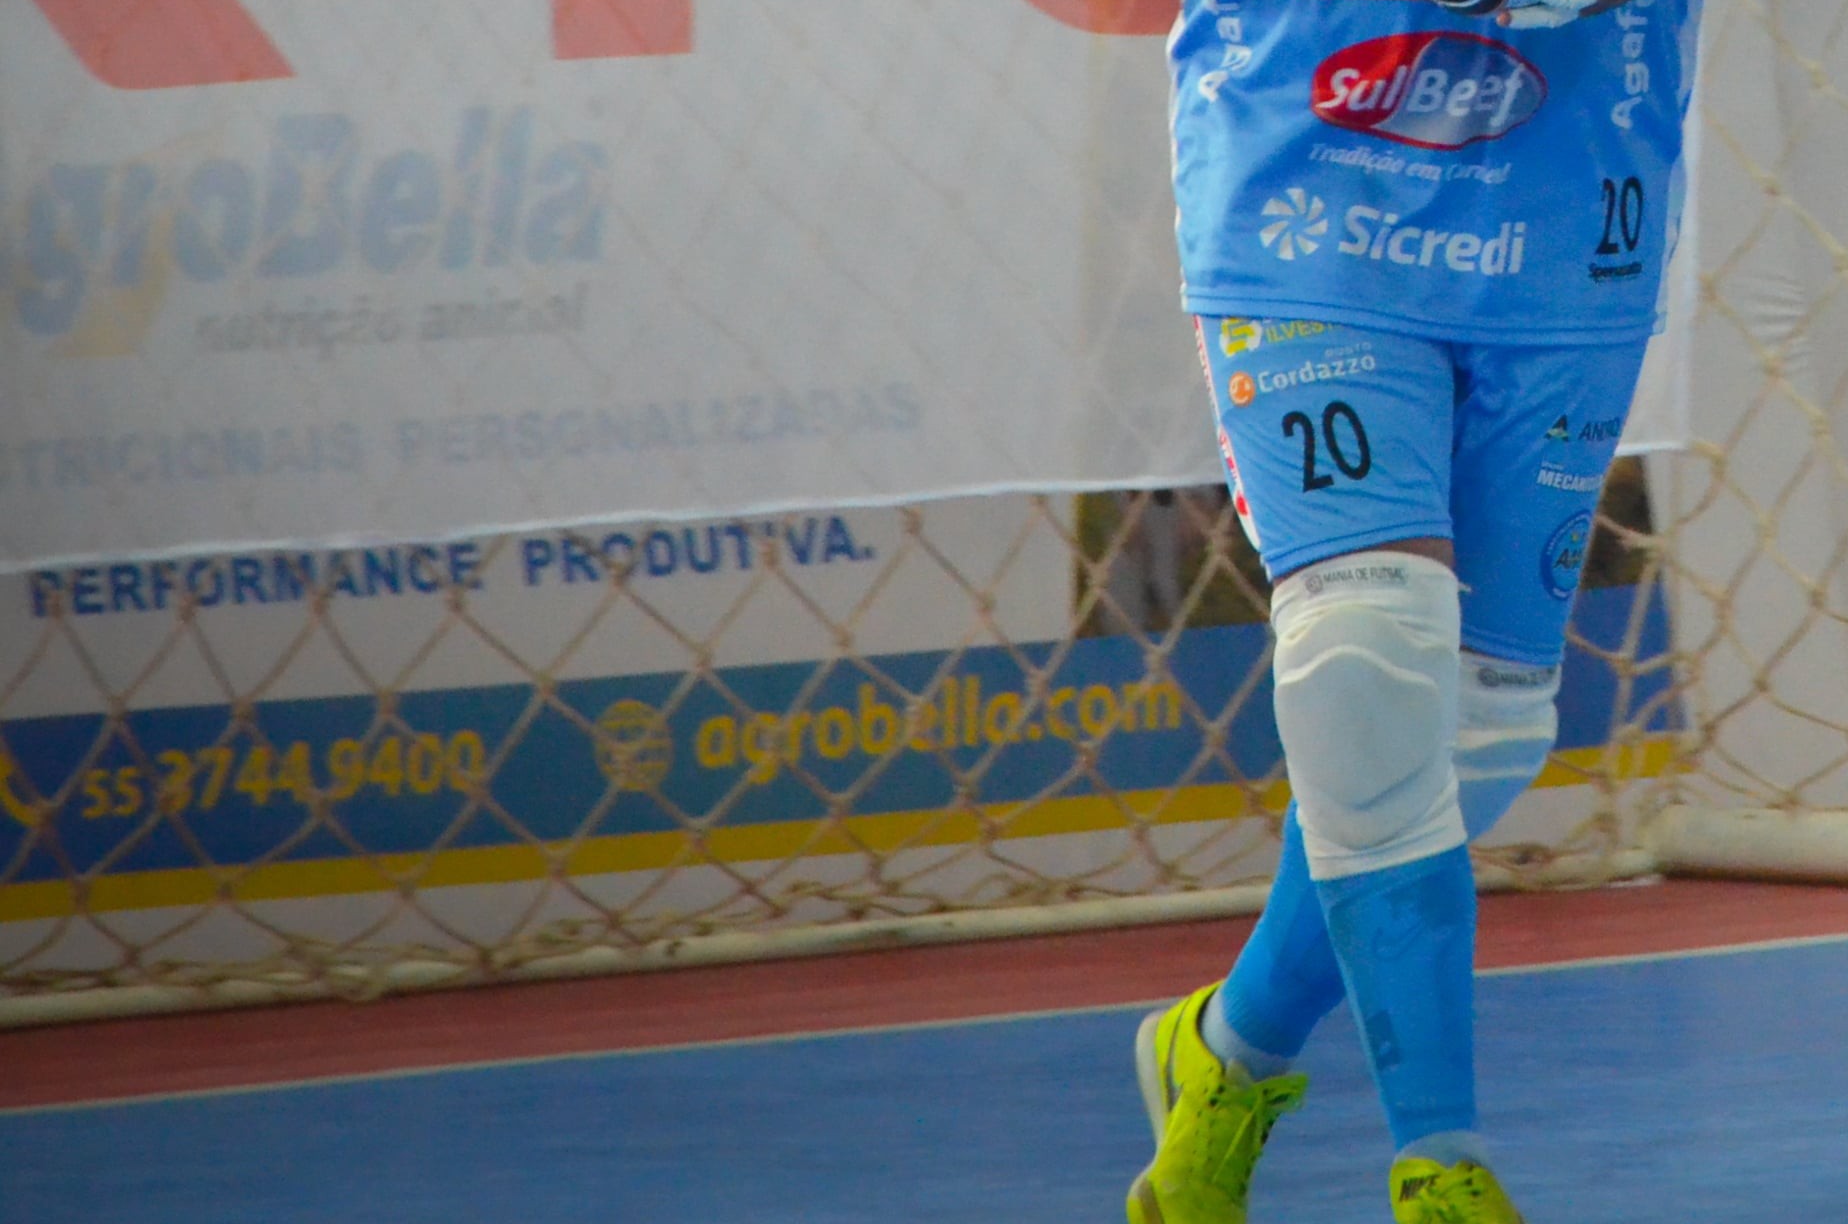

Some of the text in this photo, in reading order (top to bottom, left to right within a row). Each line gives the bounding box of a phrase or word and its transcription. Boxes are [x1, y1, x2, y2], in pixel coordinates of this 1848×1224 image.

[1338, 204, 1526, 275] Sicredi
[1594, 175, 1644, 254] 20
[1257, 354, 1376, 393] Cordazzo
[1282, 401, 1371, 493] 20
